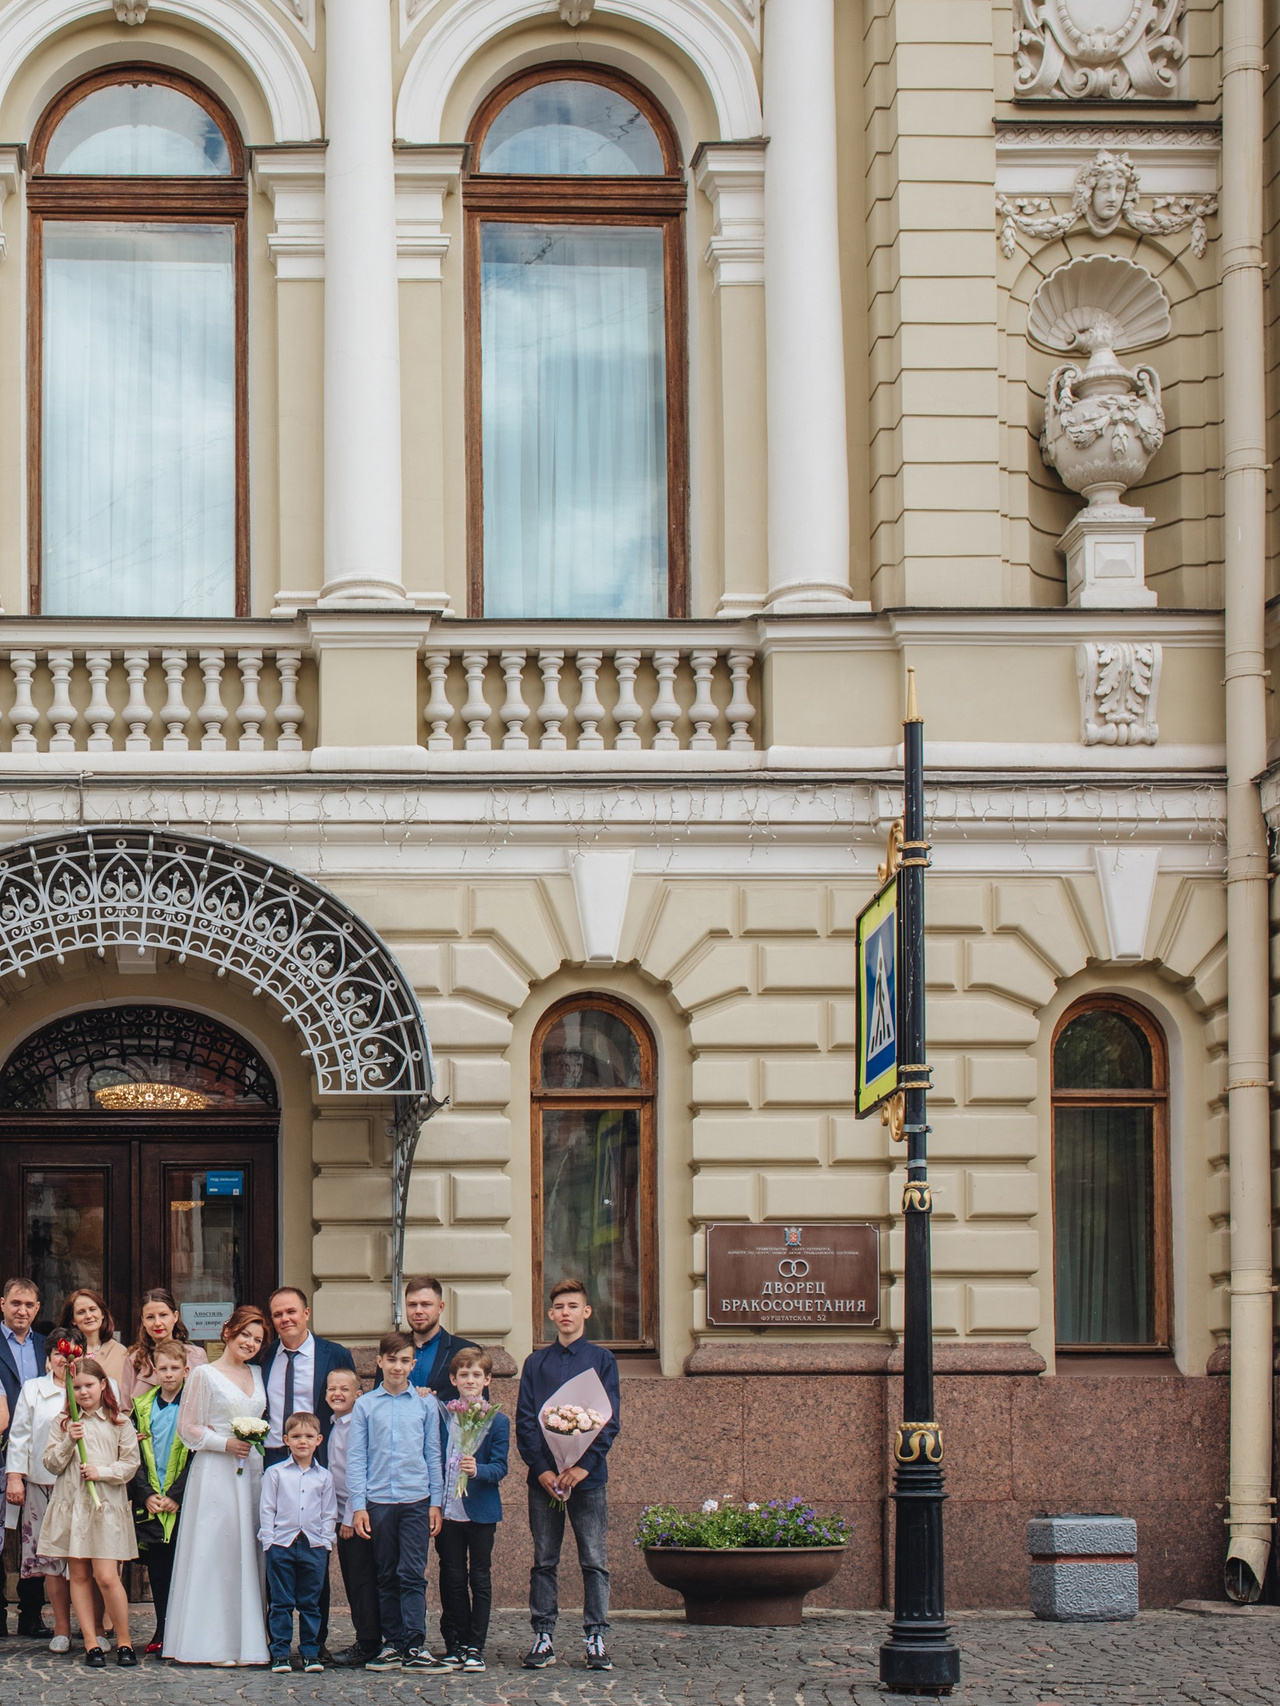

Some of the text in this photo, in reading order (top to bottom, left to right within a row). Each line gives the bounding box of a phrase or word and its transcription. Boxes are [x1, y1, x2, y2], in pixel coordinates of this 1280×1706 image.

[762, 1281, 826, 1295] ДВОРЕЦ
[721, 1299, 866, 1312] БРАКОСОЧЕТАНИЯ
[816, 1314, 827, 1322] 52
